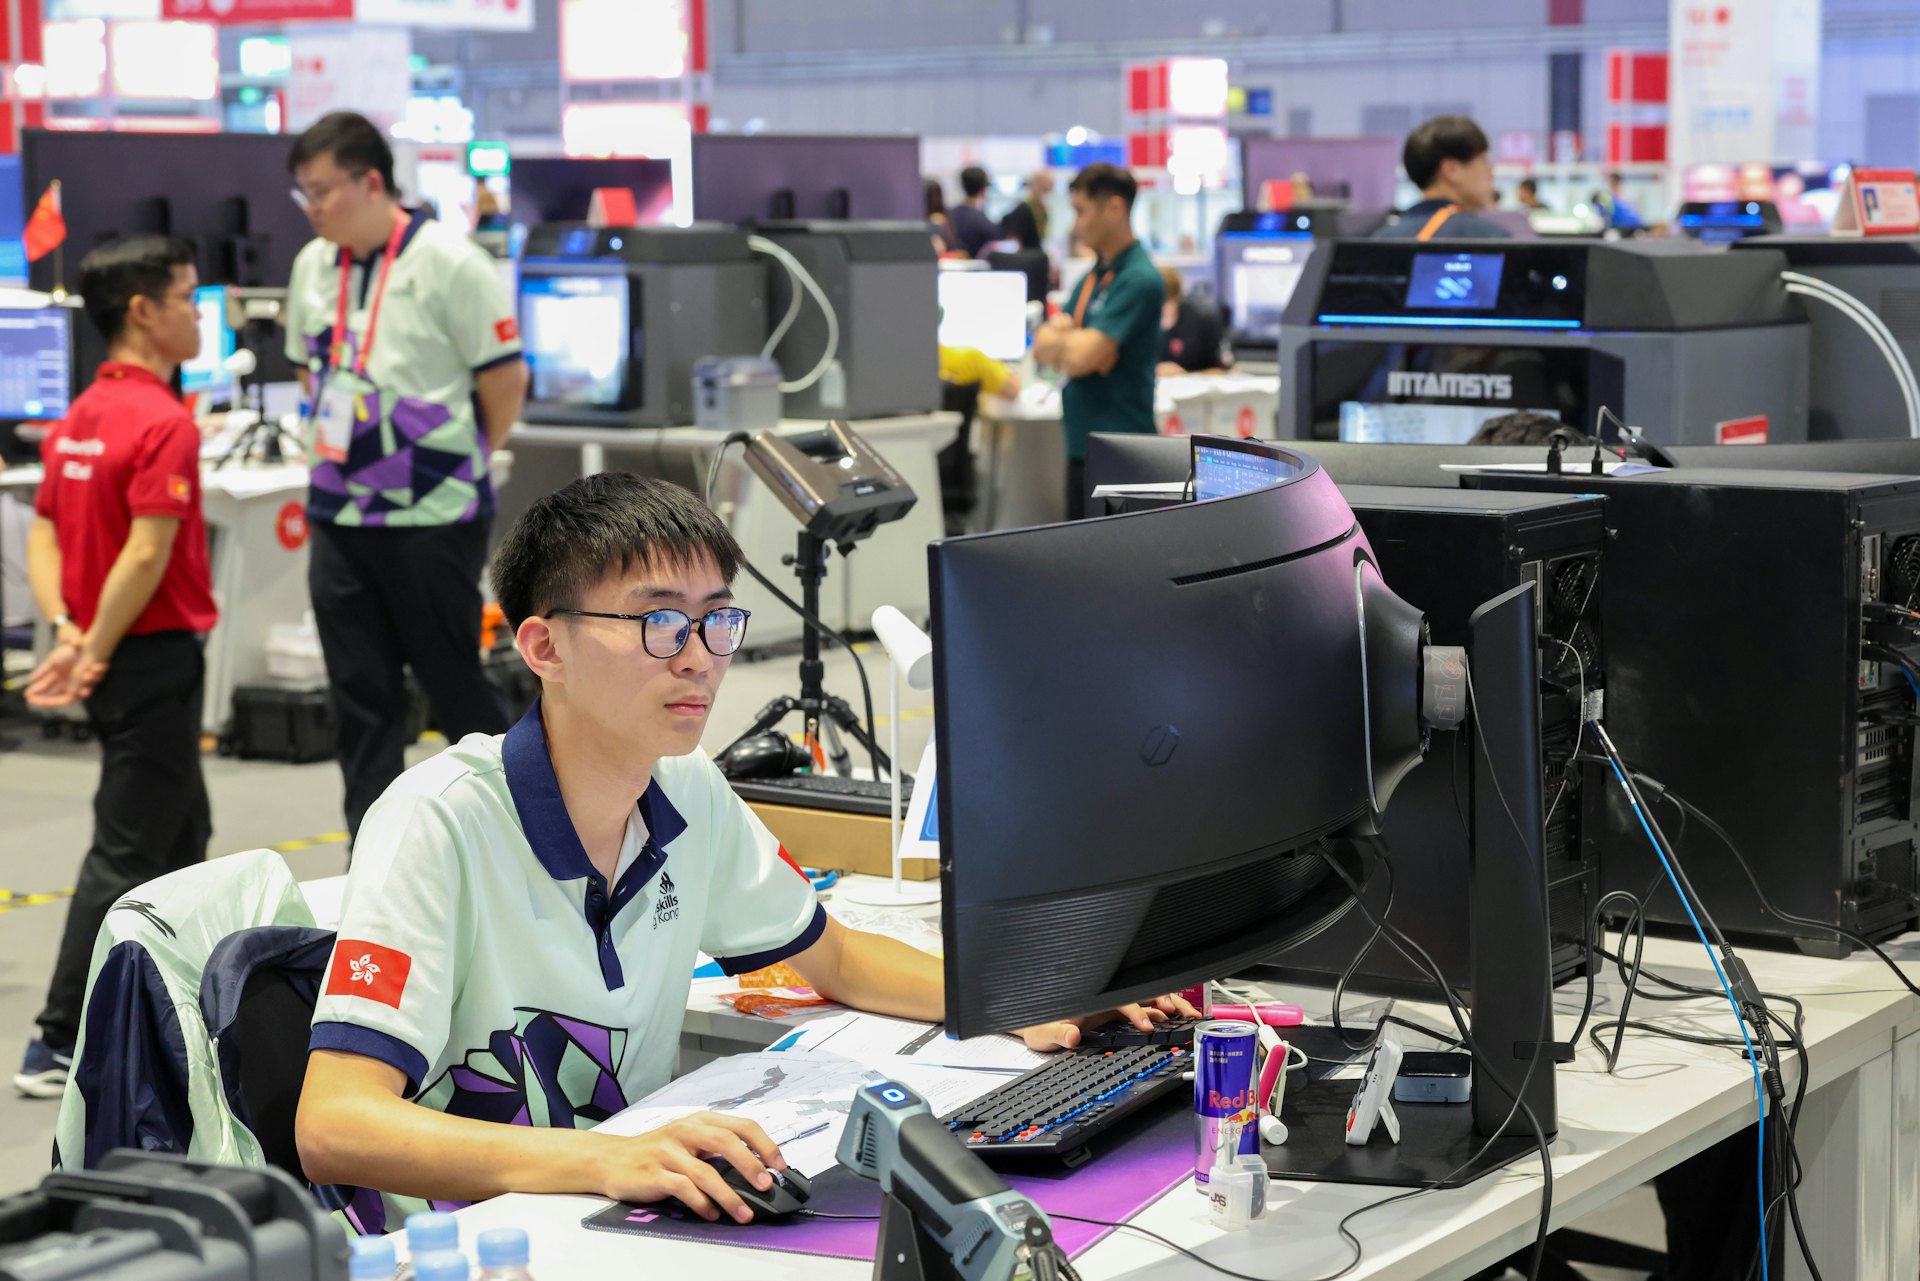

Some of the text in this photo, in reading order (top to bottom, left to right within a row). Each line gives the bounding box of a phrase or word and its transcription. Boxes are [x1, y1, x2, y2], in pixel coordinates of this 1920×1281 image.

[1388, 371, 1513, 400] INTAMSYS
[657, 907, 680, 924] Kong
[1208, 1089, 1245, 1109] Red
[1211, 1126, 1248, 1135] ENERGY
